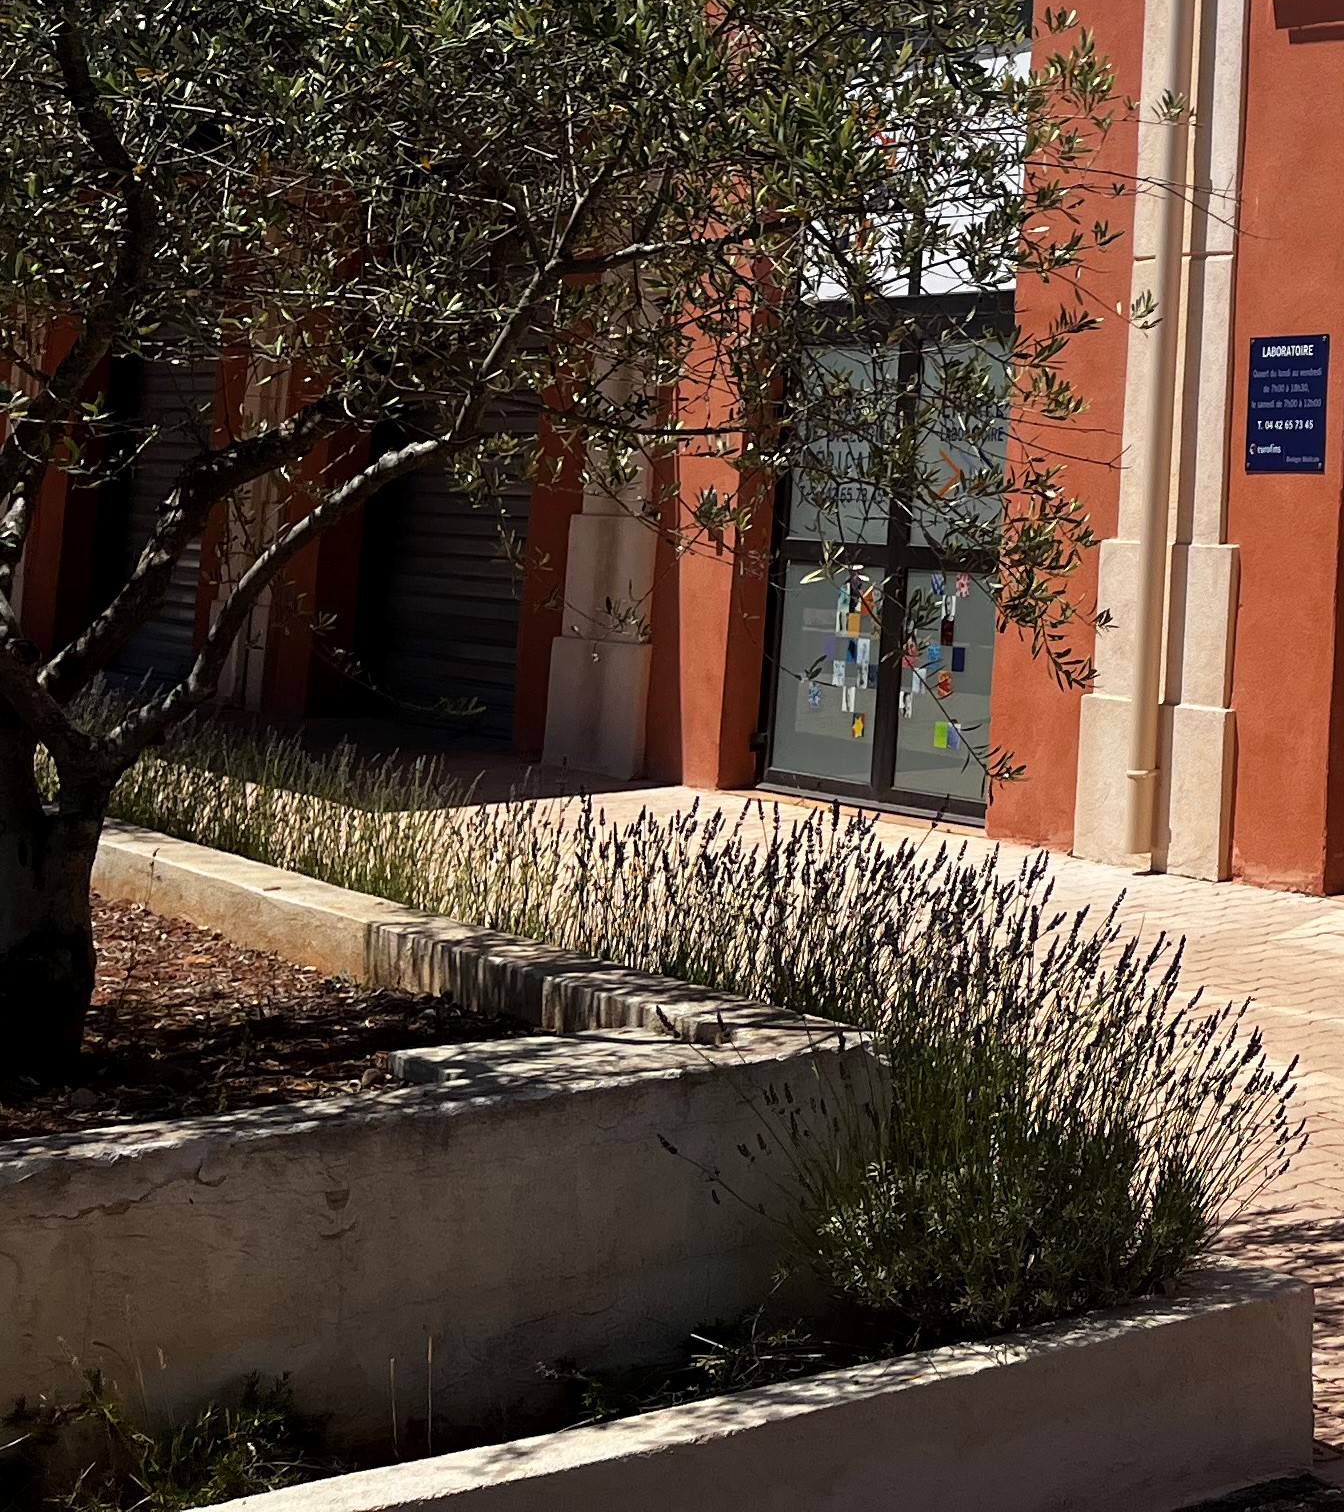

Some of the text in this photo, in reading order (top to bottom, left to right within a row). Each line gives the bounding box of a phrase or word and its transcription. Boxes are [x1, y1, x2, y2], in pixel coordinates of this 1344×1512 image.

[1262, 344, 1315, 358] LABORATOIRE
[1265, 420, 1274, 430] 04
[1274, 420, 1284, 430] 42
[1284, 420, 1294, 430] 65
[1294, 420, 1304, 430] 73
